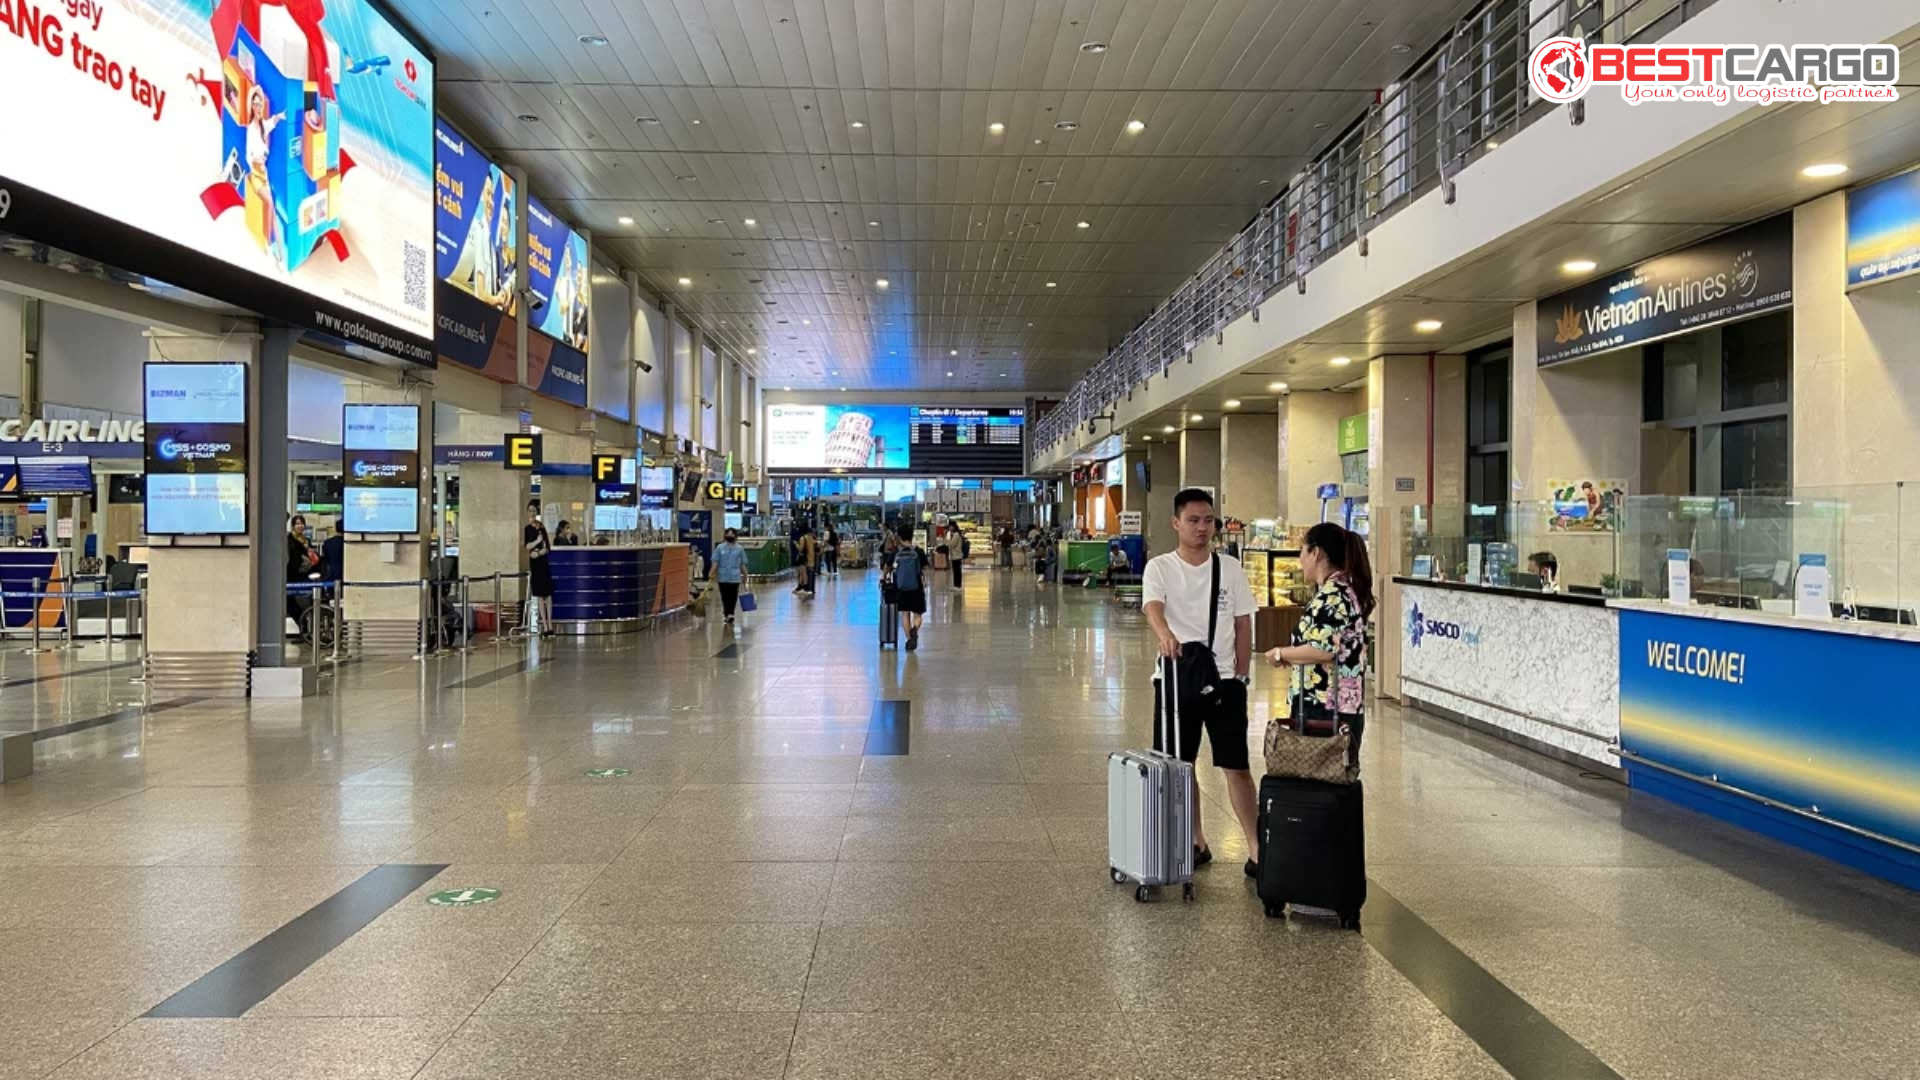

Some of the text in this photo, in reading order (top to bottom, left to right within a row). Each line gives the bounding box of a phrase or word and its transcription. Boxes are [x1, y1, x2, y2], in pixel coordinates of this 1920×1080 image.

[60, 0, 103, 31] gay
[71, 32, 123, 90] trao
[129, 66, 166, 121] tay
[955, 408, 988, 417] Departures
[42, 442, 63, 453] E-3
[476, 450, 494, 458] ROW
[511, 437, 533, 466] E
[598, 457, 615, 480] F
[708, 481, 724, 499] G
[733, 487, 746, 501] H
[1426, 620, 1460, 640] SASCO
[1647, 639, 1746, 684] WELCOME!
